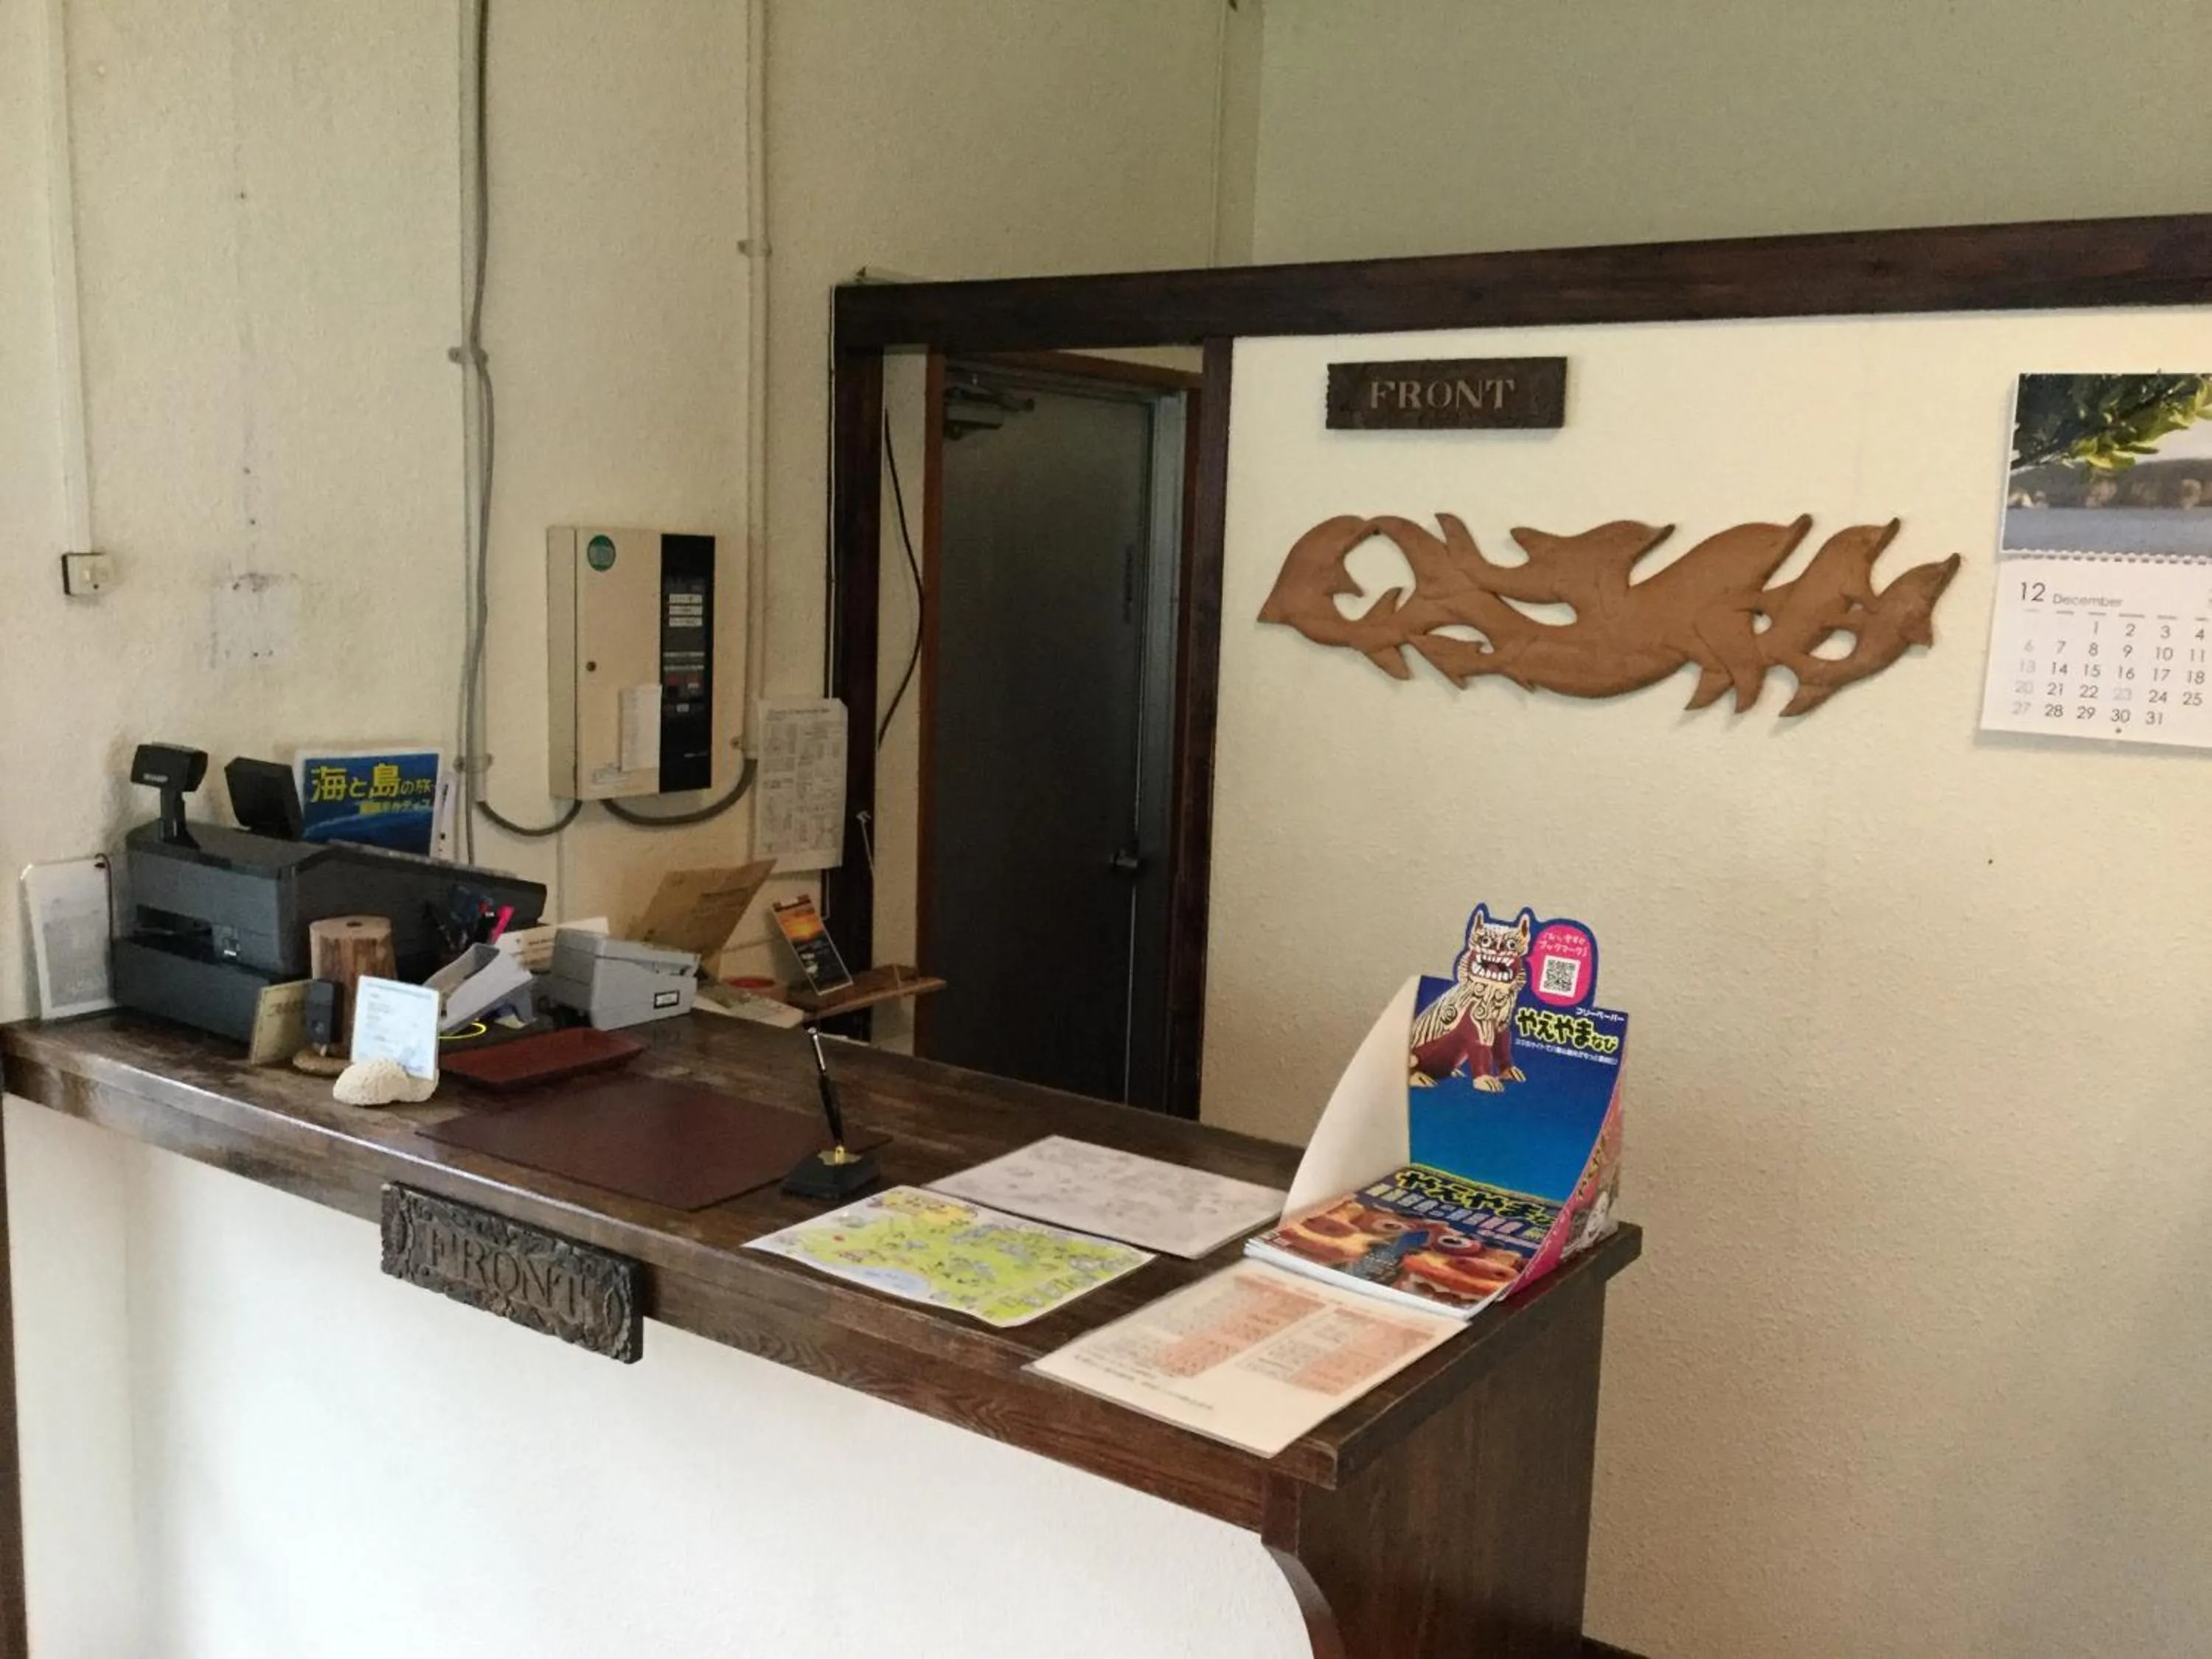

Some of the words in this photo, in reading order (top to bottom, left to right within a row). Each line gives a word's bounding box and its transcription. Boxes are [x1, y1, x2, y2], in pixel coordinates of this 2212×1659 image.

[1370, 379, 1514, 410] FRONT
[2021, 582, 2046, 602] 12
[2052, 593, 2123, 608] December
[2093, 621, 2099, 635] 1
[2125, 623, 2136, 638] 2
[2160, 625, 2171, 639] 3
[2194, 628, 2205, 641] 4
[2056, 640, 2067, 654] 7
[2087, 641, 2098, 657] 8
[2123, 644, 2133, 658] 9
[2156, 646, 2174, 661] 10
[2190, 648, 2205, 663] 11
[2052, 661, 2068, 675] 14
[2084, 663, 2101, 678] 15
[2118, 665, 2135, 681] 16
[2153, 667, 2171, 682] 17
[2187, 669, 2205, 685] 18
[2046, 682, 2064, 696] 21
[2079, 684, 2099, 699] 22
[2149, 689, 2168, 703] 24
[2183, 692, 2203, 706] 25
[2044, 703, 2064, 718] 28
[2076, 705, 2096, 720] 29
[2111, 709, 2131, 724] 30
[2145, 710, 2163, 726] 31
[1515, 1007, 1618, 1053] やえやまなび
[428, 1227, 588, 1318] FRONT
